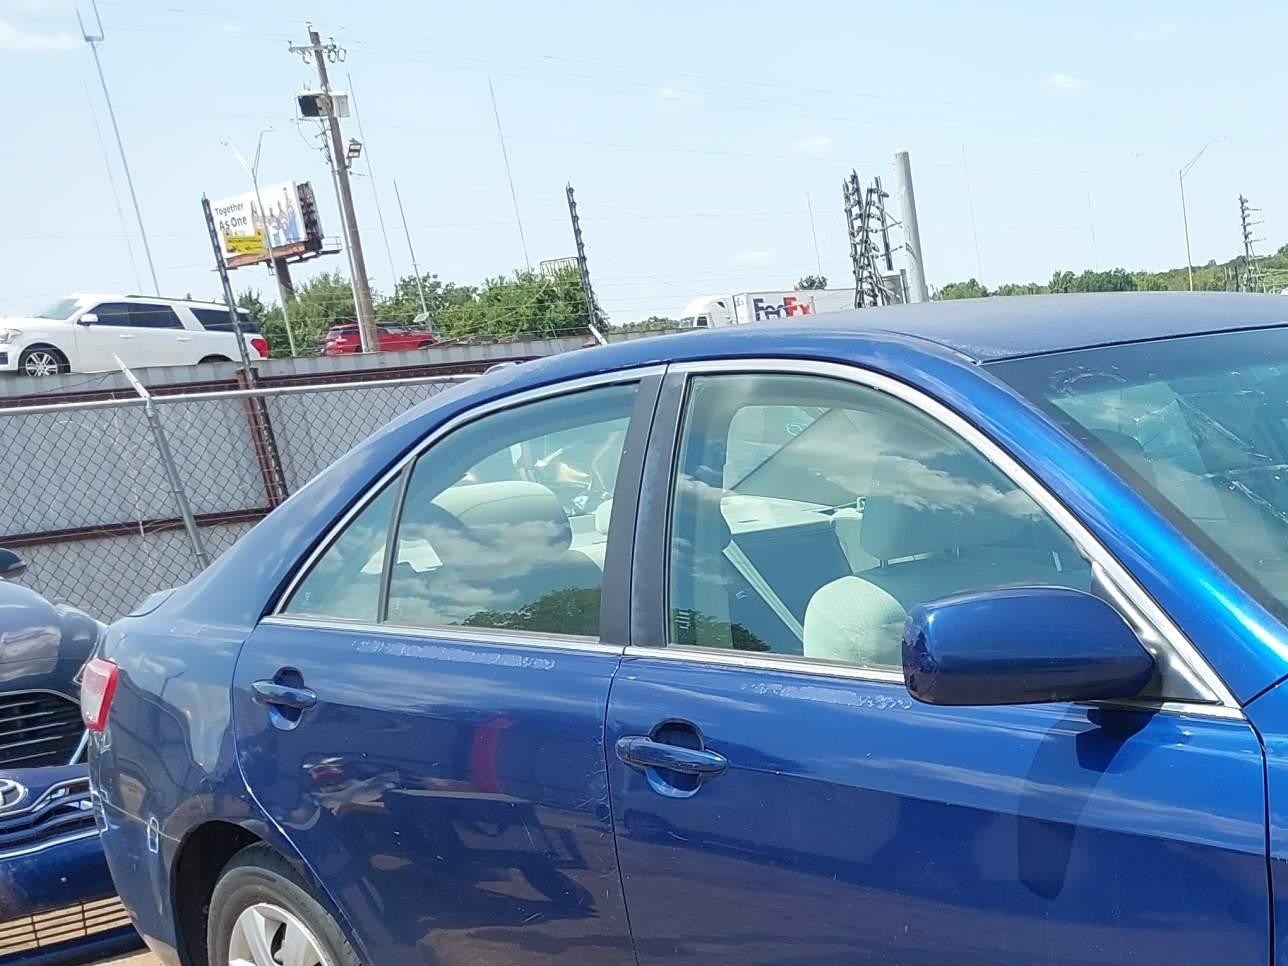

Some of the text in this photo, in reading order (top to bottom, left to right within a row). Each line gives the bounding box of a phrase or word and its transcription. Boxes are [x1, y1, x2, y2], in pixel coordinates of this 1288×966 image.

[214, 202, 244, 216] Together
[219, 216, 248, 231] As One
[753, 297, 811, 322] FedEx
